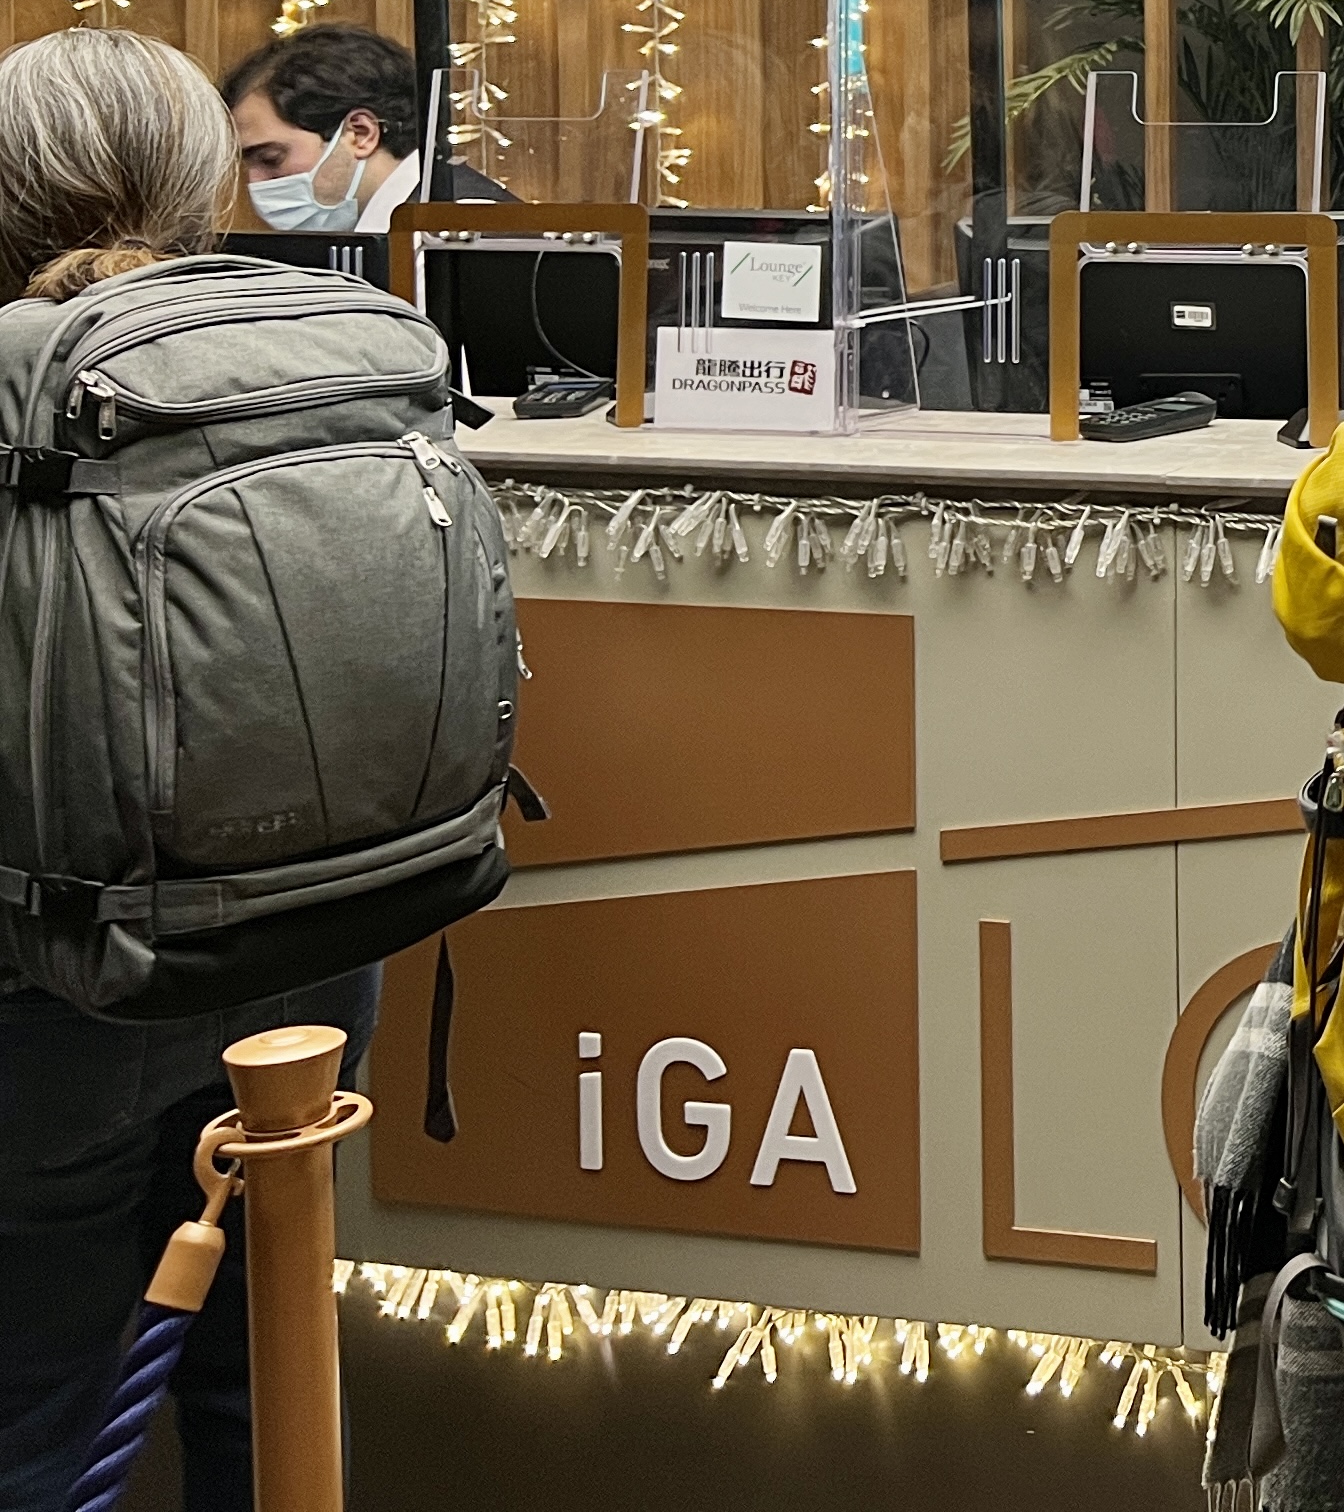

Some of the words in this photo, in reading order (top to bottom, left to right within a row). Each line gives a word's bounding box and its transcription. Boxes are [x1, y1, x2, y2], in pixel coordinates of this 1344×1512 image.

[751, 256, 803, 276] Lounge
[672, 378, 786, 395] DRAGONPASS
[578, 1031, 858, 1194] iGA
